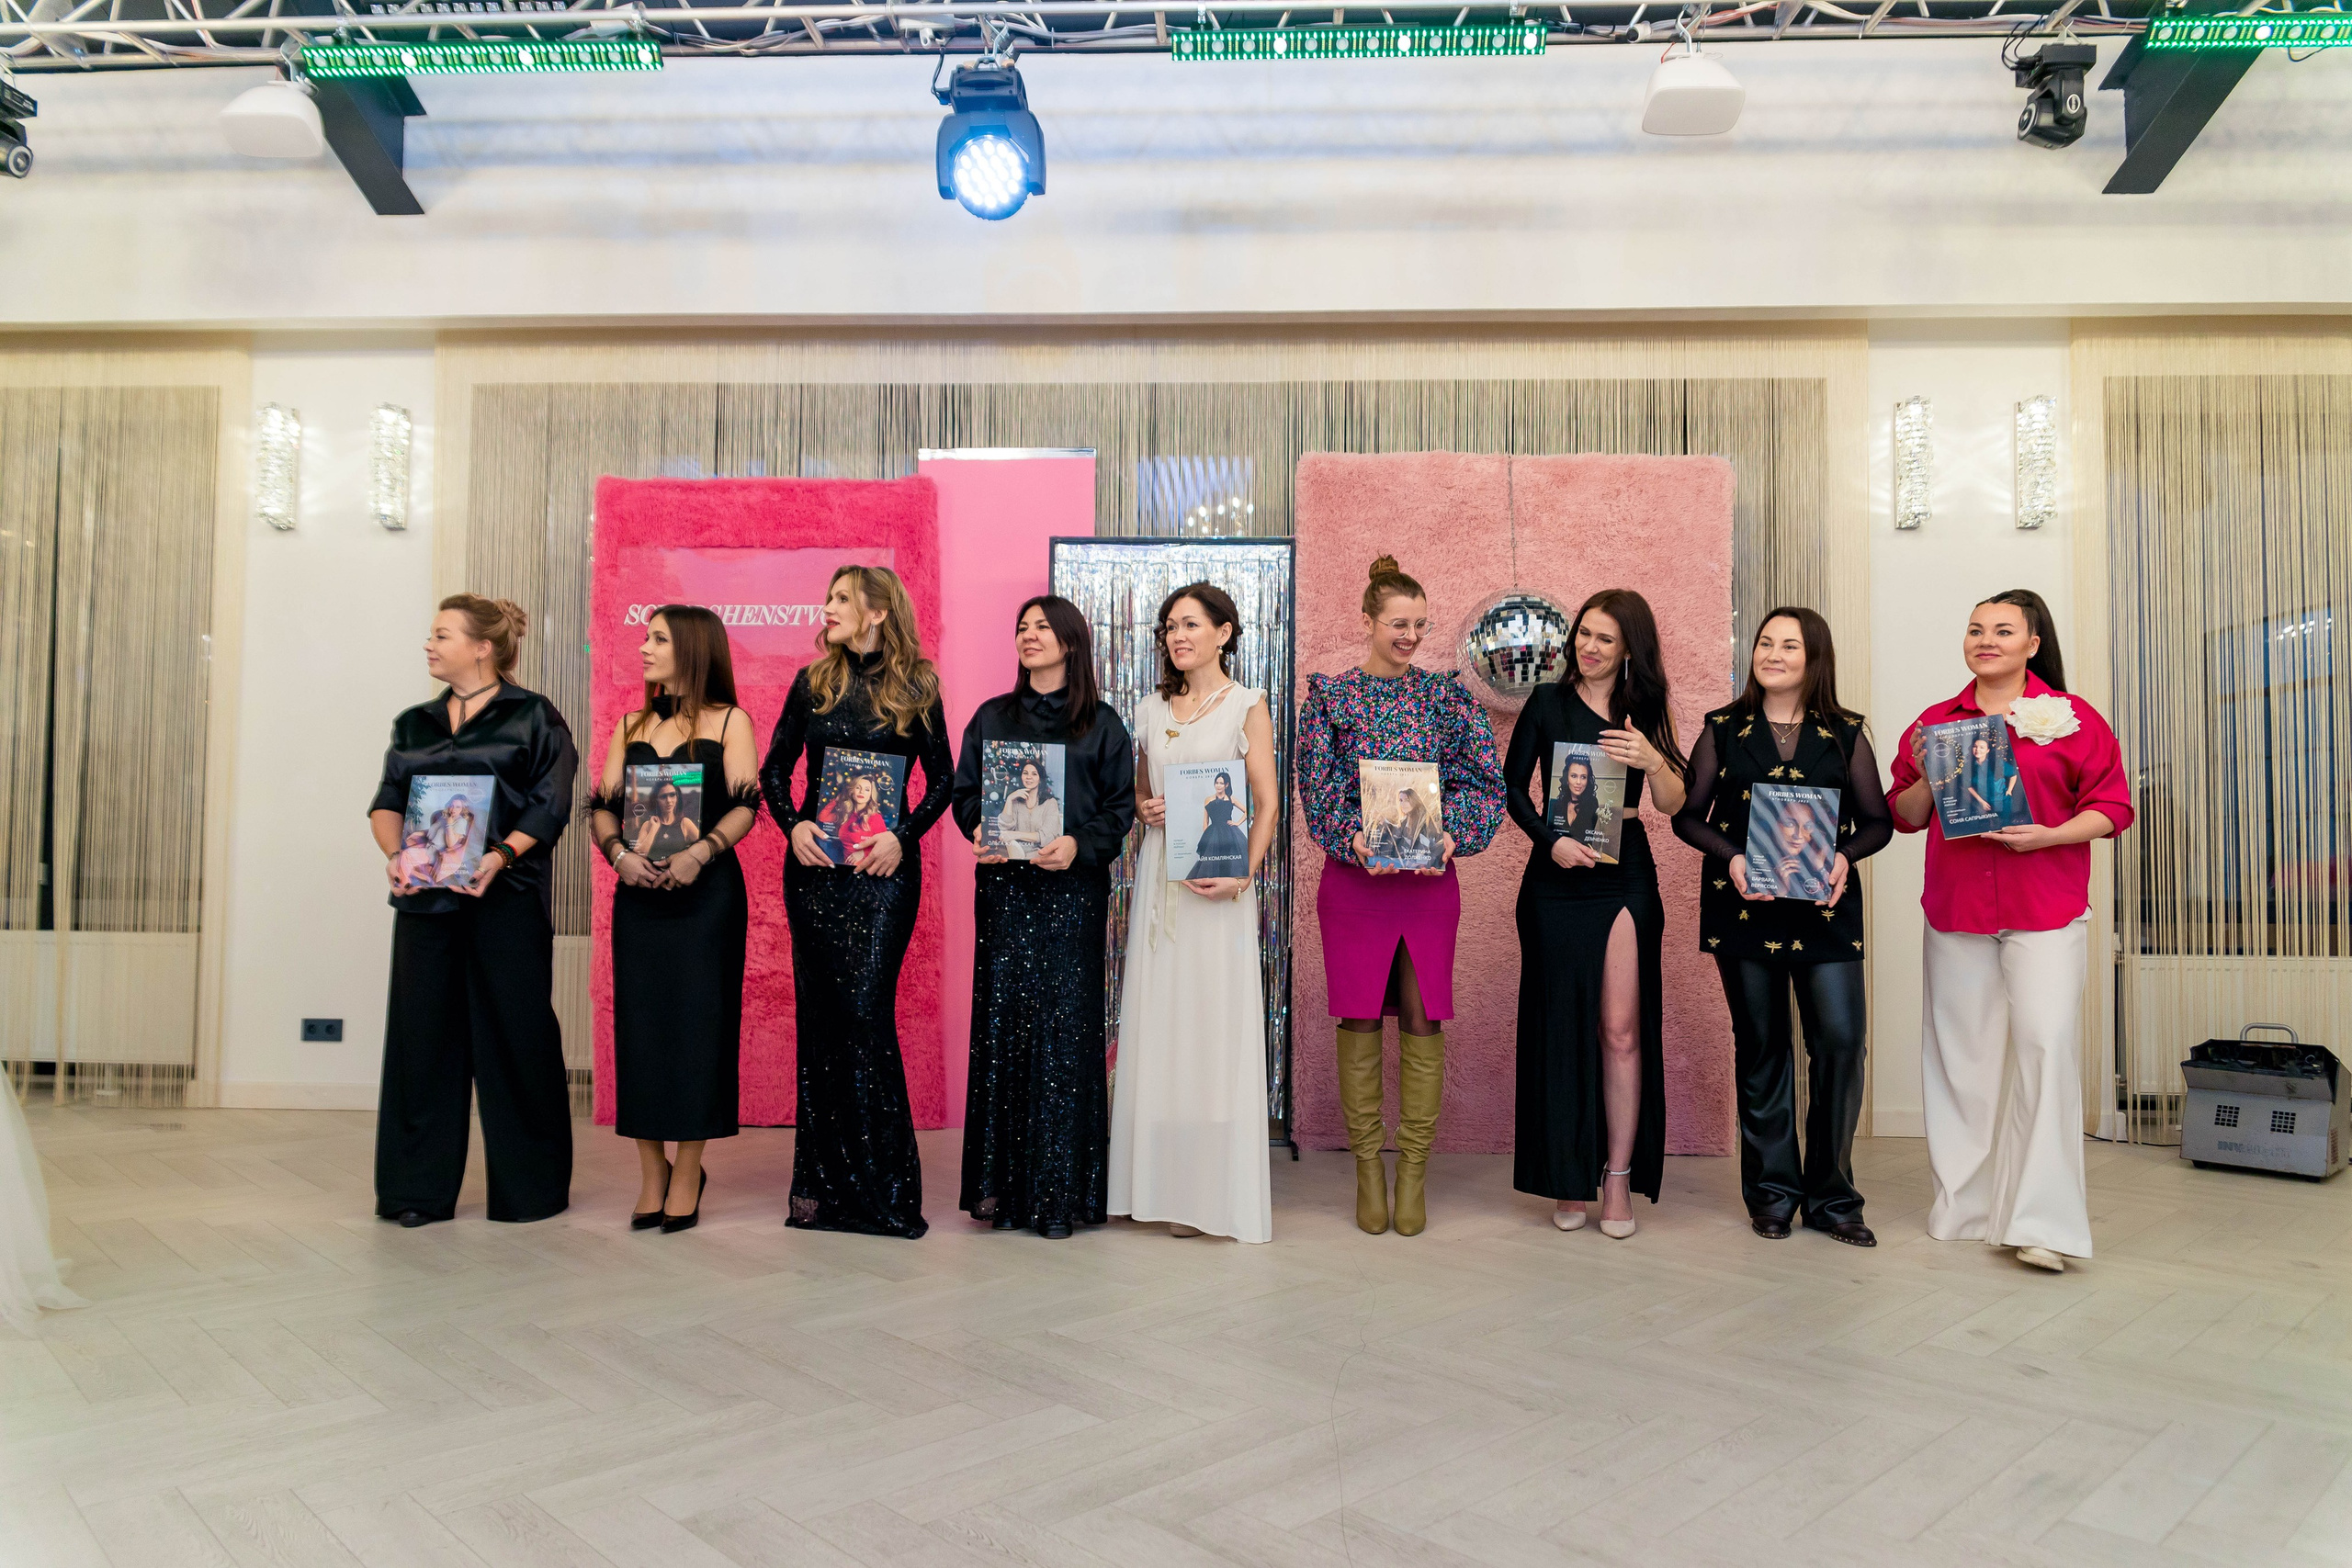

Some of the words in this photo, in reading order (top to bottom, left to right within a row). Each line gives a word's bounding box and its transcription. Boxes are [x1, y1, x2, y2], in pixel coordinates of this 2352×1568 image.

[1934, 728, 1960, 737] FORBES
[1961, 723, 1988, 732] WOMAN
[841, 755, 864, 764] FORBES
[865, 759, 889, 767] WOMAN
[1769, 790, 1794, 798] FORBES
[1795, 792, 1823, 800] WOMAN
